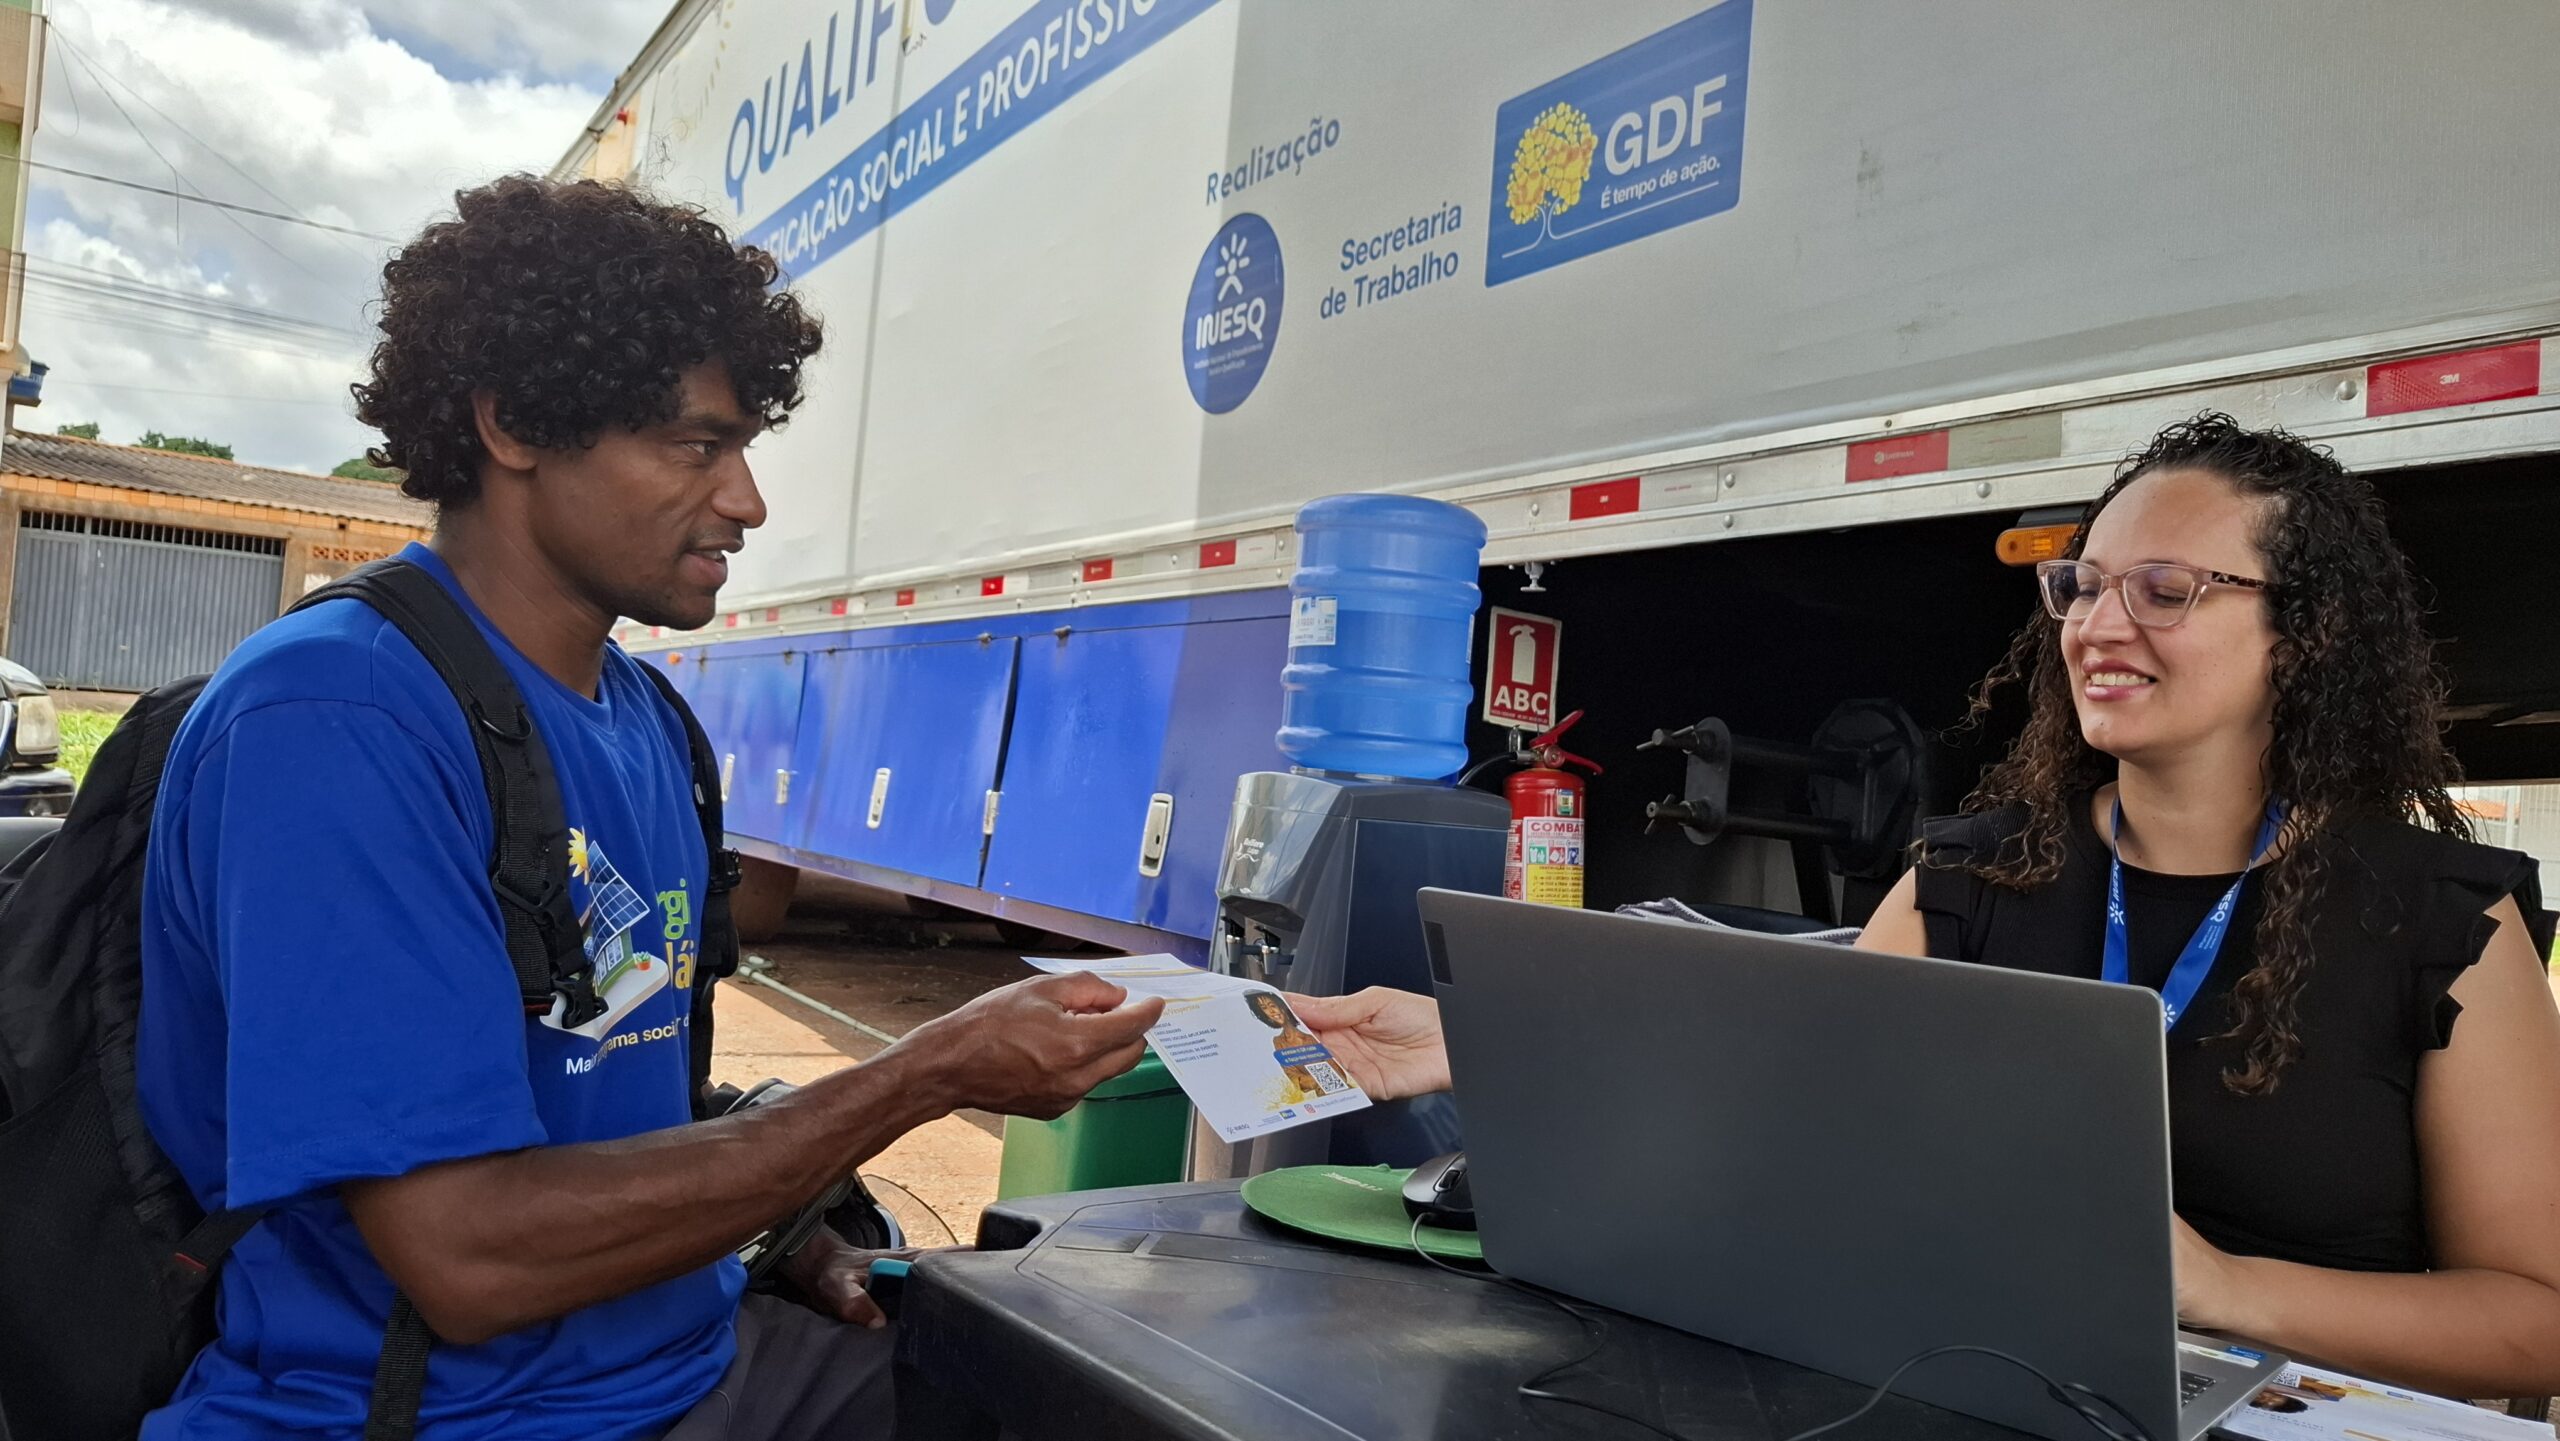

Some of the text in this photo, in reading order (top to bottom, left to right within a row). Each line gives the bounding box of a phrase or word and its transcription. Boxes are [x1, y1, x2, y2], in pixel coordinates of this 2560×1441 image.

[725, 0, 955, 218] QUALIF
[858, 107, 946, 213] SOCIAL
[952, 86, 971, 148] E
[976, 0, 1156, 131] PROFISSI
[1604, 74, 1727, 176] GDF
[1206, 115, 1341, 206] Realização
[1601, 155, 1720, 209] É tempo de ação.
[1340, 201, 1462, 272] Secretaria
[1320, 251, 1459, 319] de Trabalho
[1195, 297, 1266, 351] INESQ
[2439, 373, 2460, 385] 3M
[1494, 685, 1548, 715] ABC
